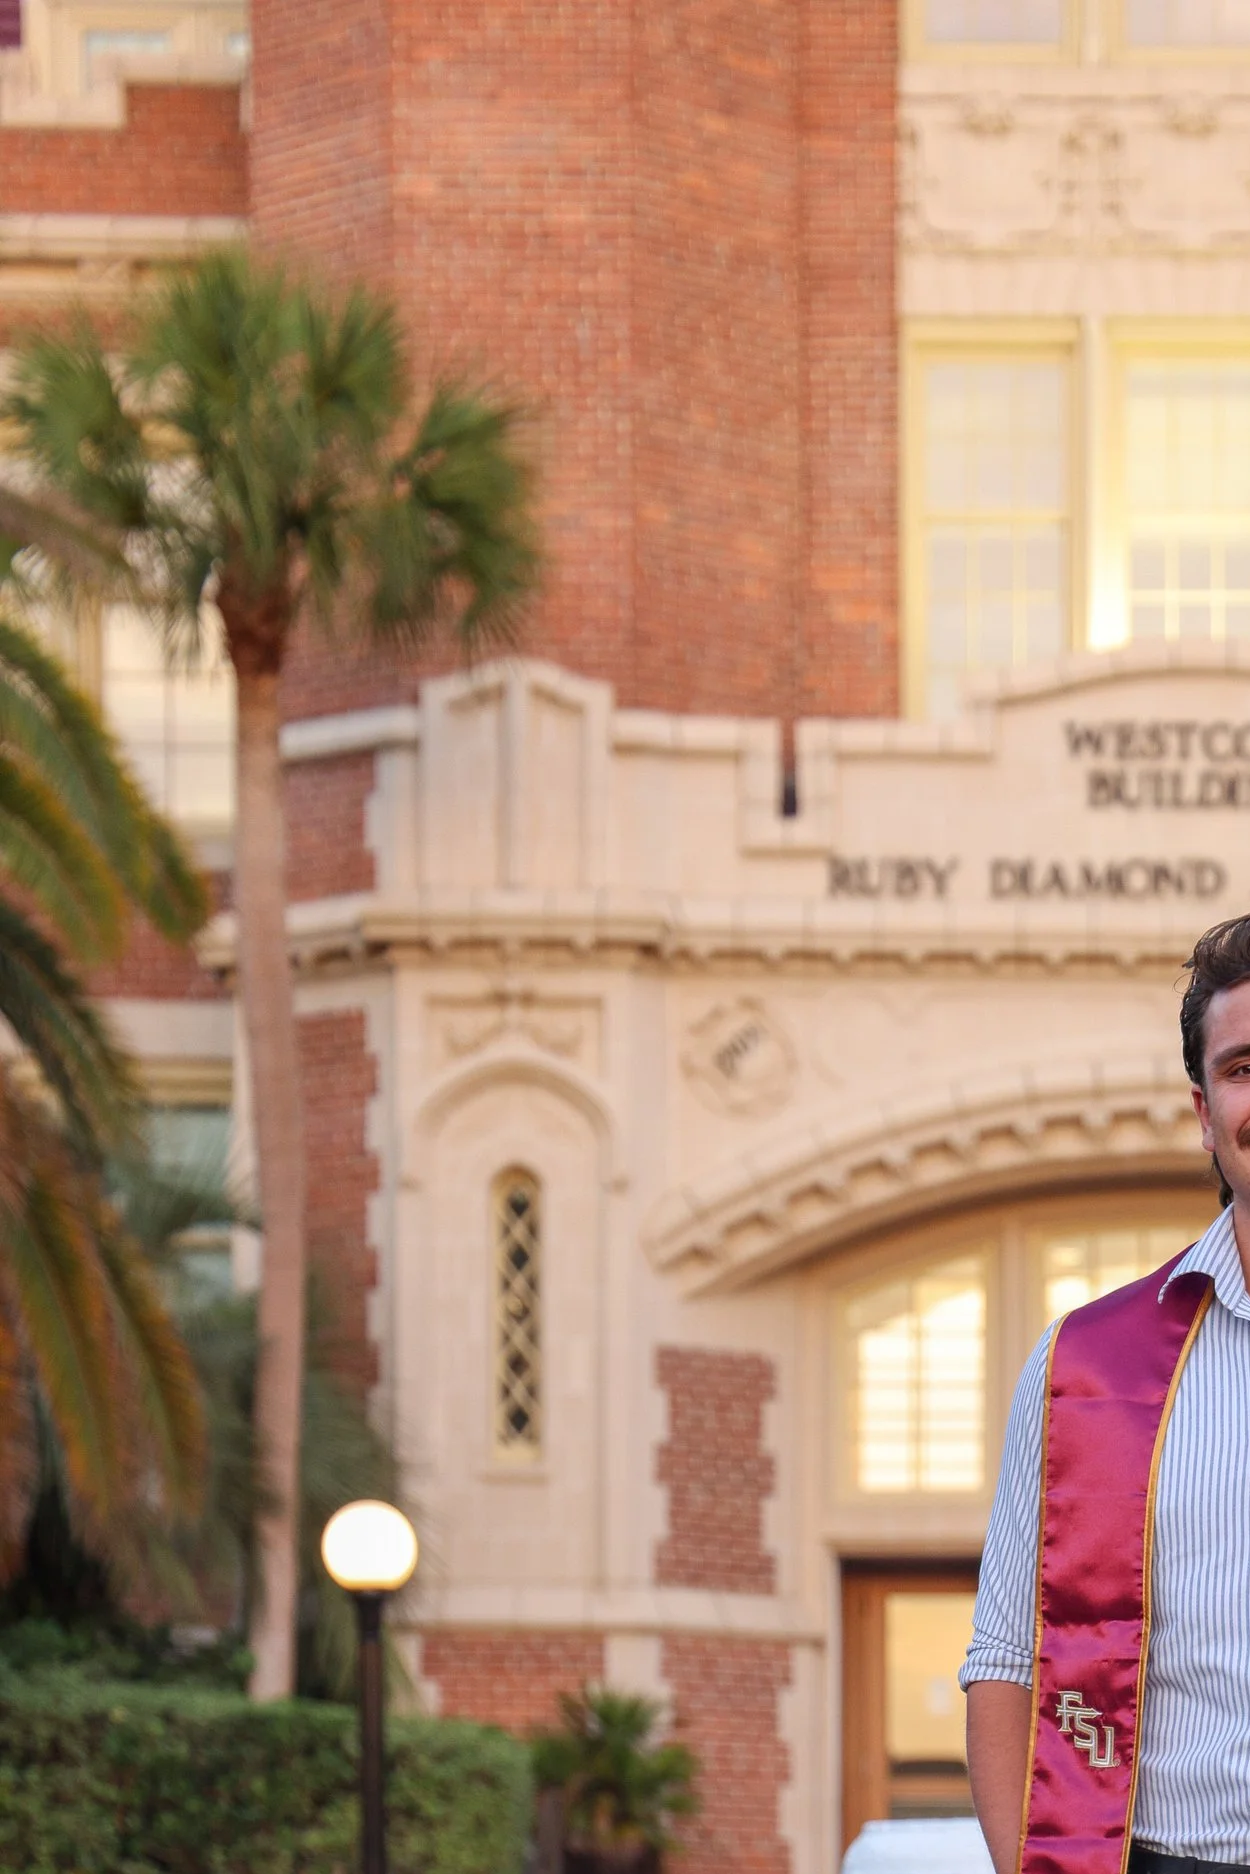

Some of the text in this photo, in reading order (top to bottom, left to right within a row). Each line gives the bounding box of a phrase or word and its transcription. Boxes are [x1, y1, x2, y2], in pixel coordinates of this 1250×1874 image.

[829, 855, 957, 899] RUBY
[990, 855, 1230, 899] DIAMOND
[1056, 1690, 1116, 1767] FSU
